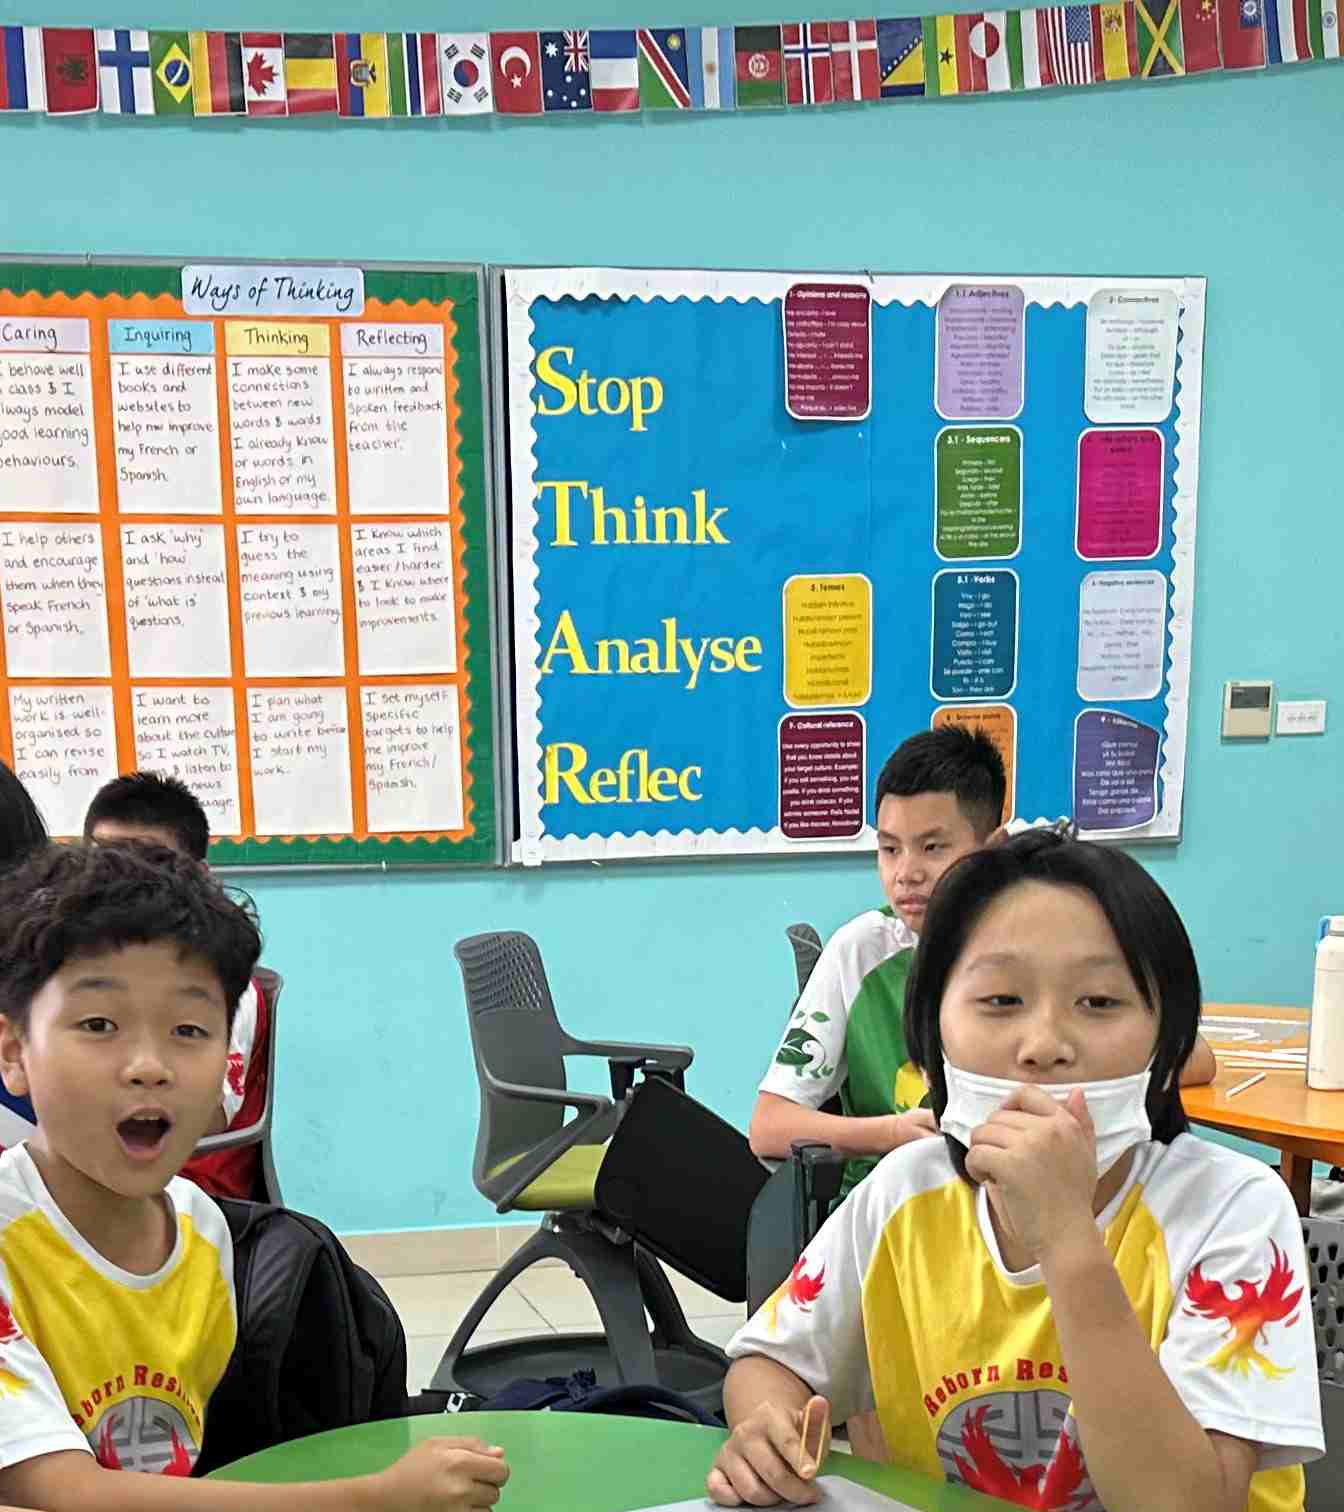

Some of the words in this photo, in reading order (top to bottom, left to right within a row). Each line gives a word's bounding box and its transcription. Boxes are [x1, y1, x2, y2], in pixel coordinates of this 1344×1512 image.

[192, 275, 240, 311] Ways
[249, 278, 267, 307] of
[274, 276, 354, 312] Thinking
[2, 323, 58, 352] Caring
[124, 327, 192, 352] Inquiring
[244, 328, 309, 353] Thinking
[356, 328, 427, 354] Reflecting
[9, 362, 55, 377] behave
[59, 363, 84, 377] well
[62, 382, 75, 395] I
[535, 345, 664, 432] Stop
[44, 403, 84, 416] model
[34, 426, 89, 447] learning
[536, 480, 730, 547] Think
[540, 609, 762, 689] Analyse
[543, 741, 703, 805] Reflec
[923, 1365, 1000, 1417] Reborn
